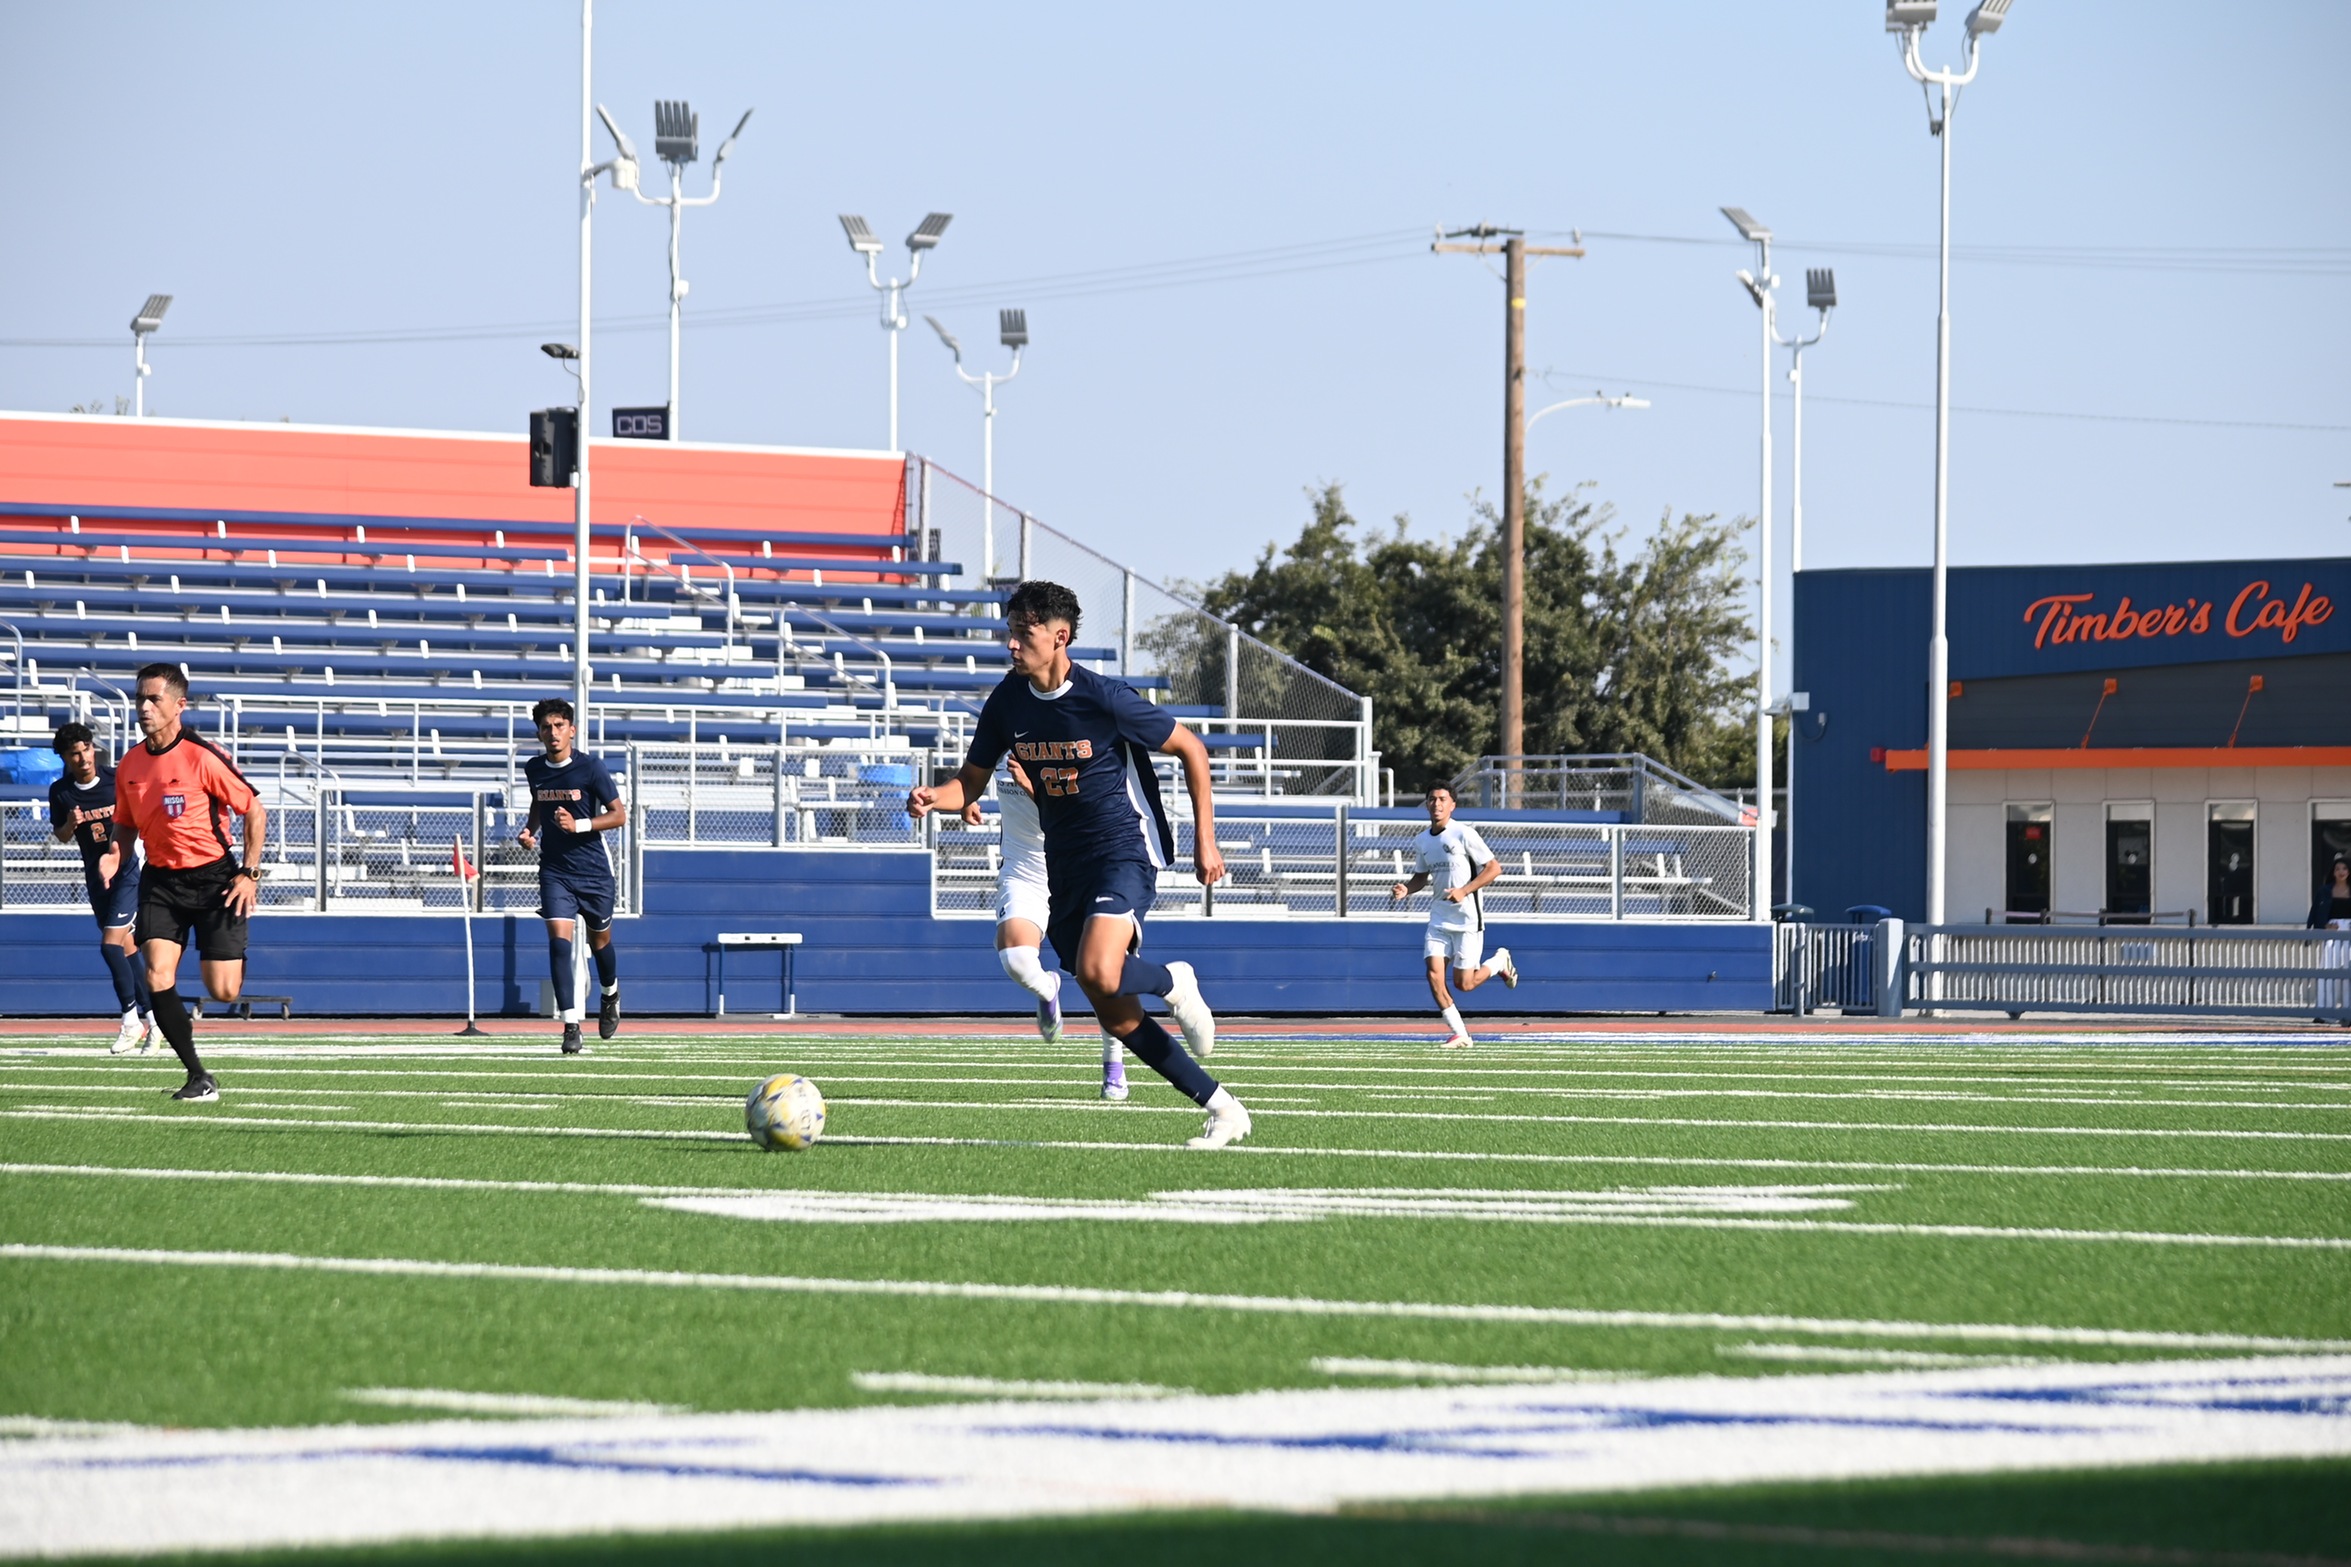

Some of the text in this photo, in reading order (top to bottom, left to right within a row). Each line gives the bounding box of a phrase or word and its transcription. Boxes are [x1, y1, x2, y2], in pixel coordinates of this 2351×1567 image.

[617, 415, 662, 434] COS
[2023, 580, 2335, 650] Timber's Cafe
[1015, 739, 1093, 760] GIANTS
[1040, 767, 1080, 796] 27
[84, 804, 115, 821] ANT
[90, 822, 108, 843] 2
